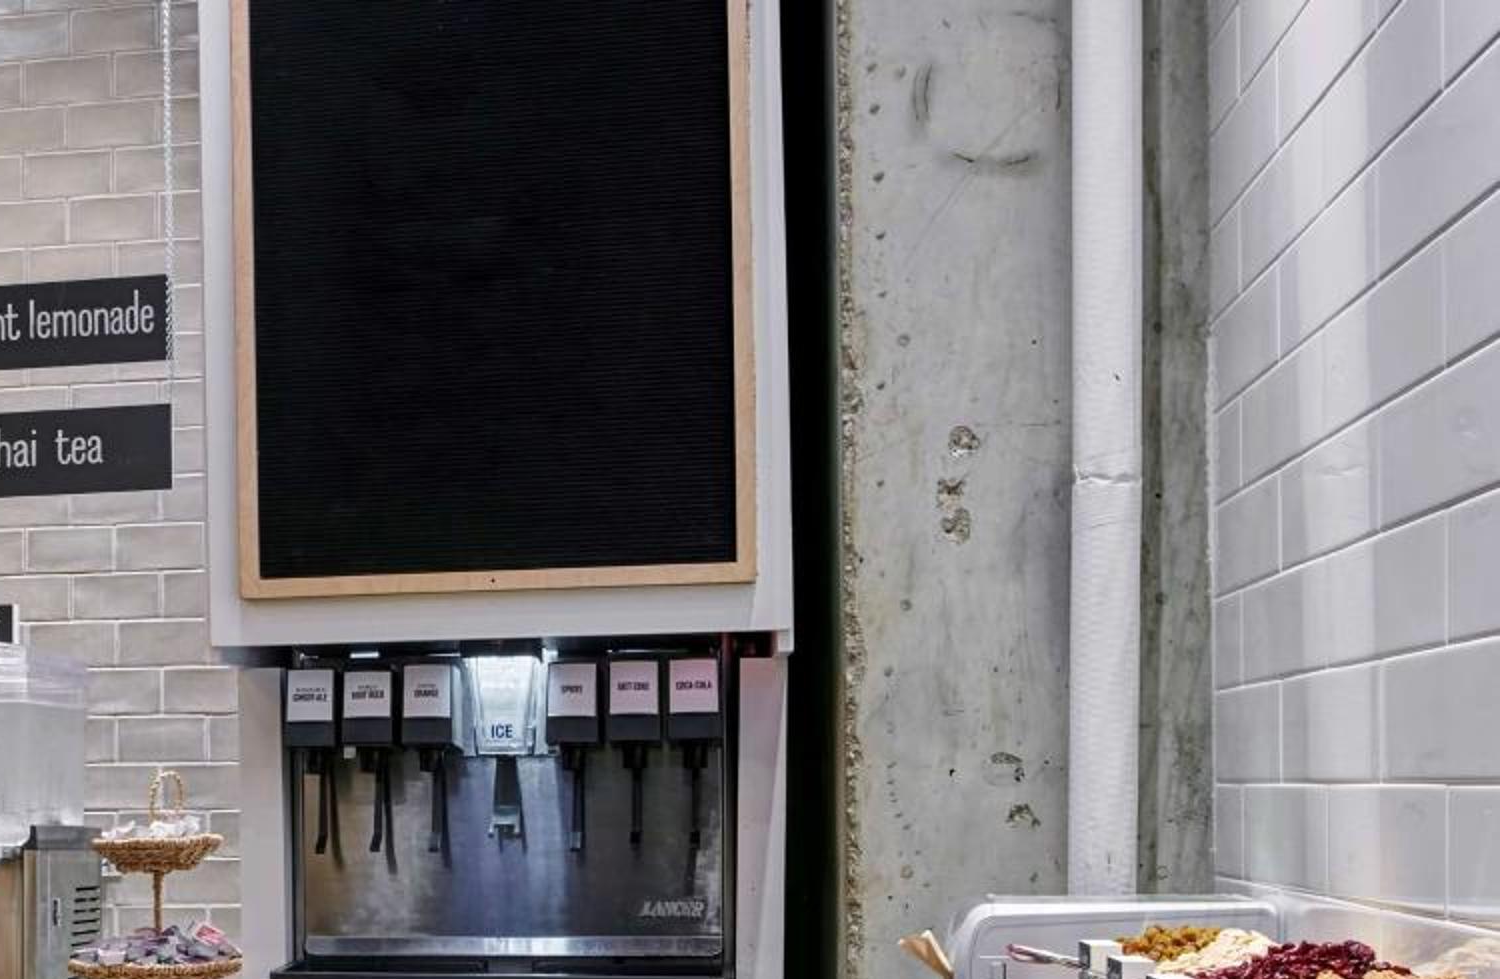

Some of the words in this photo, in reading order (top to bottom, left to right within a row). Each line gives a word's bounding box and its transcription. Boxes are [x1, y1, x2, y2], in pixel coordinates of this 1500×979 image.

[28, 288, 155, 340] lemonade
[54, 428, 104, 465] tea
[491, 723, 514, 739] ICE
